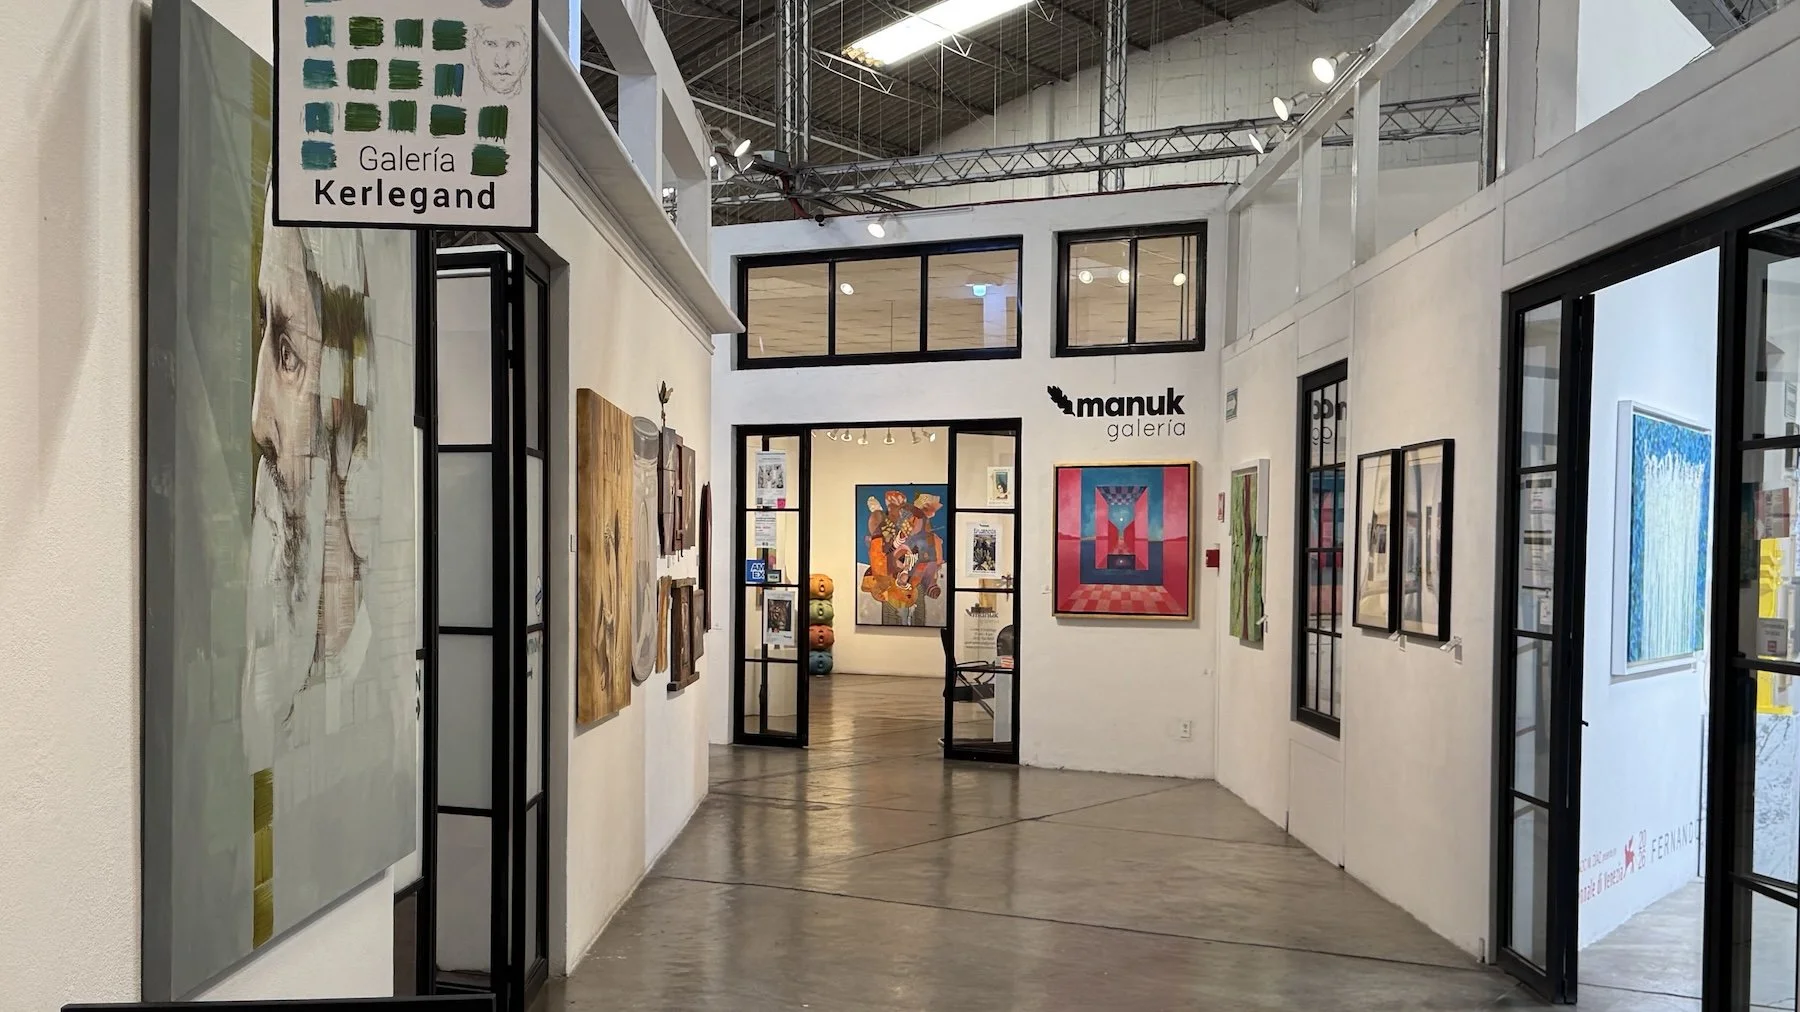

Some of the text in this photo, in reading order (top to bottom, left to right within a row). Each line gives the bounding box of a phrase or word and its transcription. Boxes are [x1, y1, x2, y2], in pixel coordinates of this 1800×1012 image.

[359, 145, 455, 173] Galería
[314, 179, 496, 214] Kerlegand
[1076, 387, 1186, 418] manuk
[1106, 419, 1187, 442] galería
